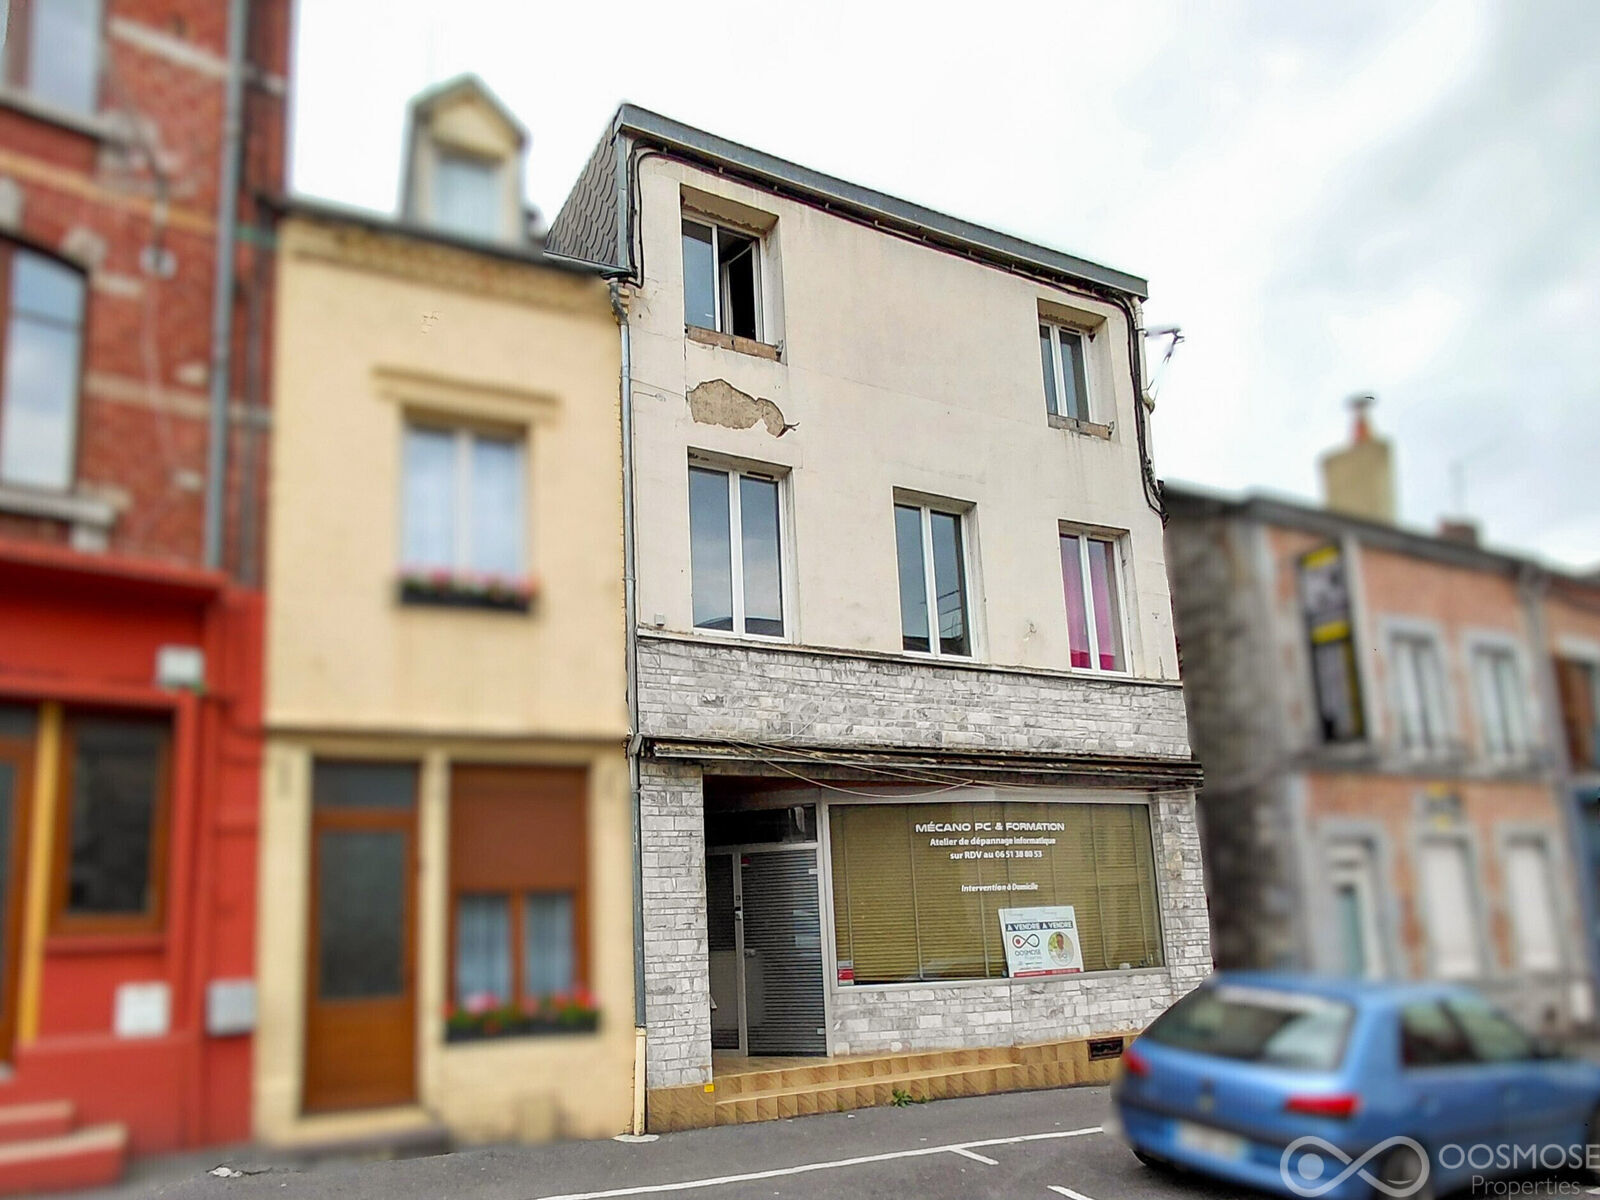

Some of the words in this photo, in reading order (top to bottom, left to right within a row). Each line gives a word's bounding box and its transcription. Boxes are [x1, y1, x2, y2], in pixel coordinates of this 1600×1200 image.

[915, 821, 971, 832] MÉCANO
[974, 822, 992, 832] PC
[994, 822, 1003, 831] &
[1006, 822, 1065, 831] FORMATION
[930, 837, 957, 846] Atelier
[958, 837, 969, 845] de
[970, 836, 1013, 846] dépannage
[950, 852, 963, 860] sur
[964, 850, 982, 859] RDV
[961, 883, 1006, 892] Intervention
